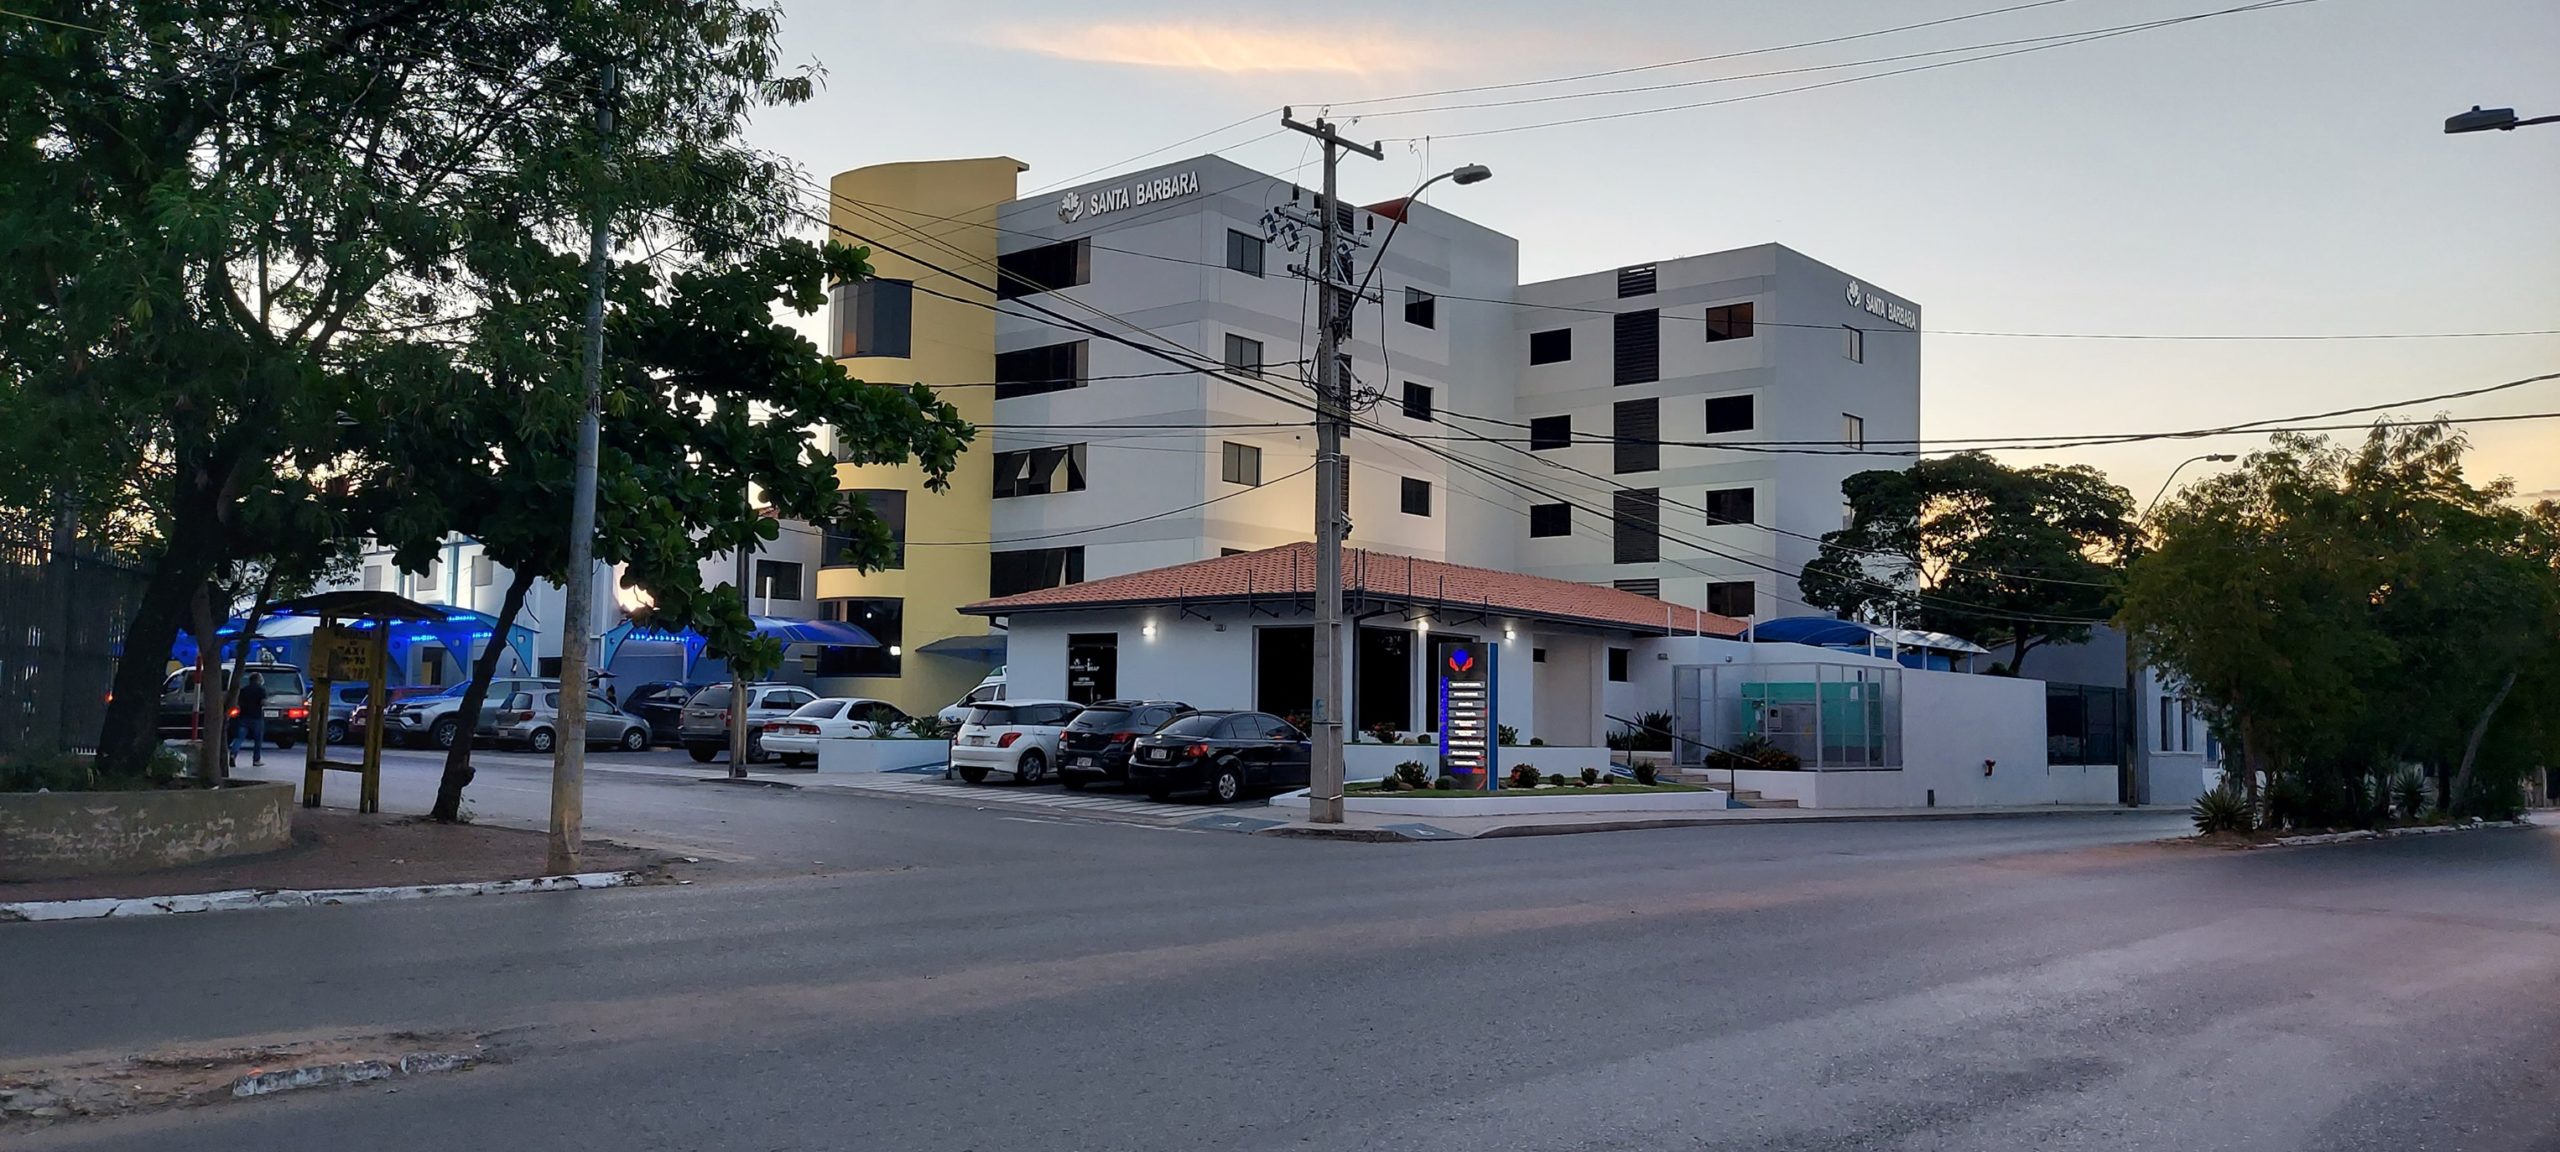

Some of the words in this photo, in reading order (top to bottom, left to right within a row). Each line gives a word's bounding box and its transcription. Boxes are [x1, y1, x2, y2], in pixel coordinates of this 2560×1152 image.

[1090, 187, 1130, 216] SANTA
[1136, 171, 1200, 206] BARBARA
[1865, 292, 1886, 318] SANTA
[1887, 302, 1917, 330] BARBARA
[337, 646, 365, 655] TAXI
